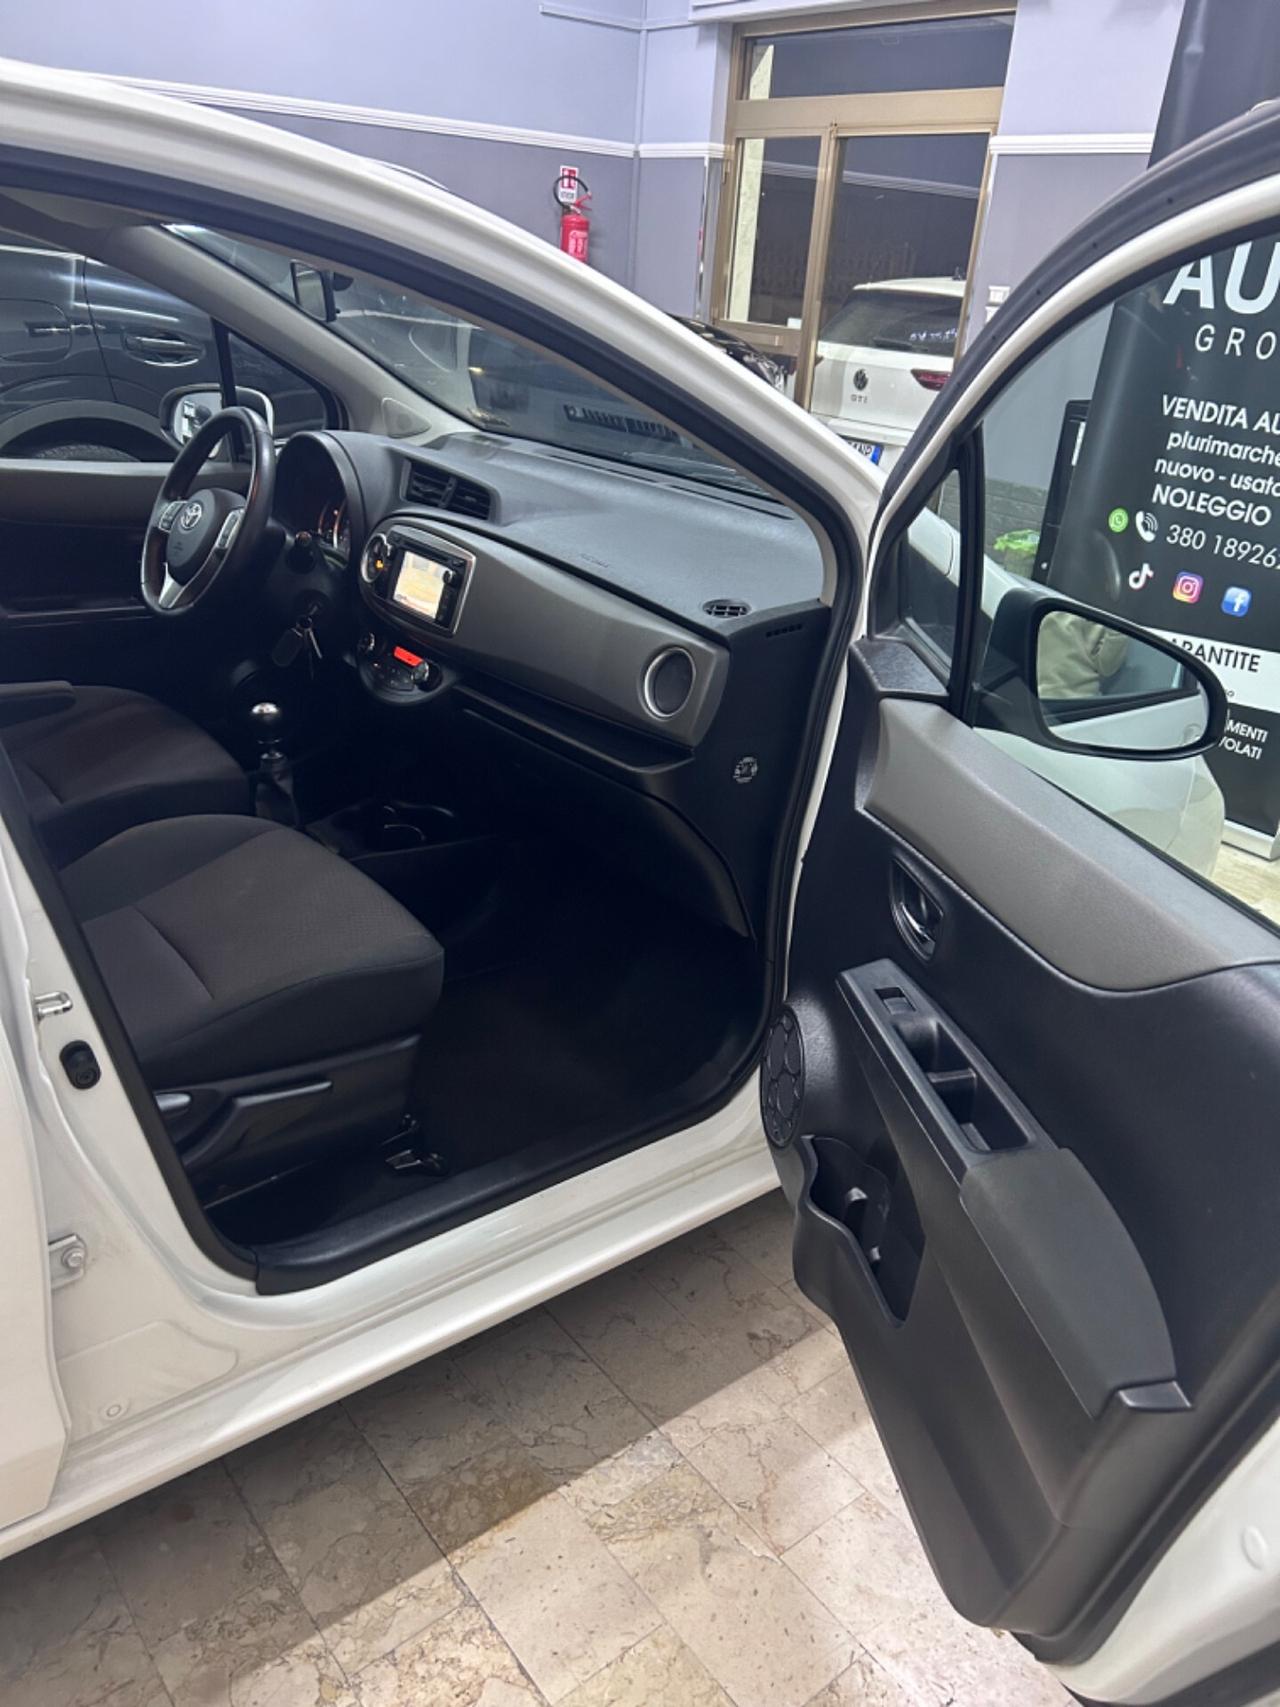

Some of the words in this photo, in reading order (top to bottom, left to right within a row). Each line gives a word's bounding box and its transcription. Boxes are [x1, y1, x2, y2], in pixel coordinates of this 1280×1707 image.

[1195, 324, 1277, 360] GRO
[1162, 394, 1248, 429] VENDITA
[1154, 458, 1215, 483] nuovo
[1152, 483, 1272, 526] NOLEGGIO
[1166, 524, 1206, 550] 380
